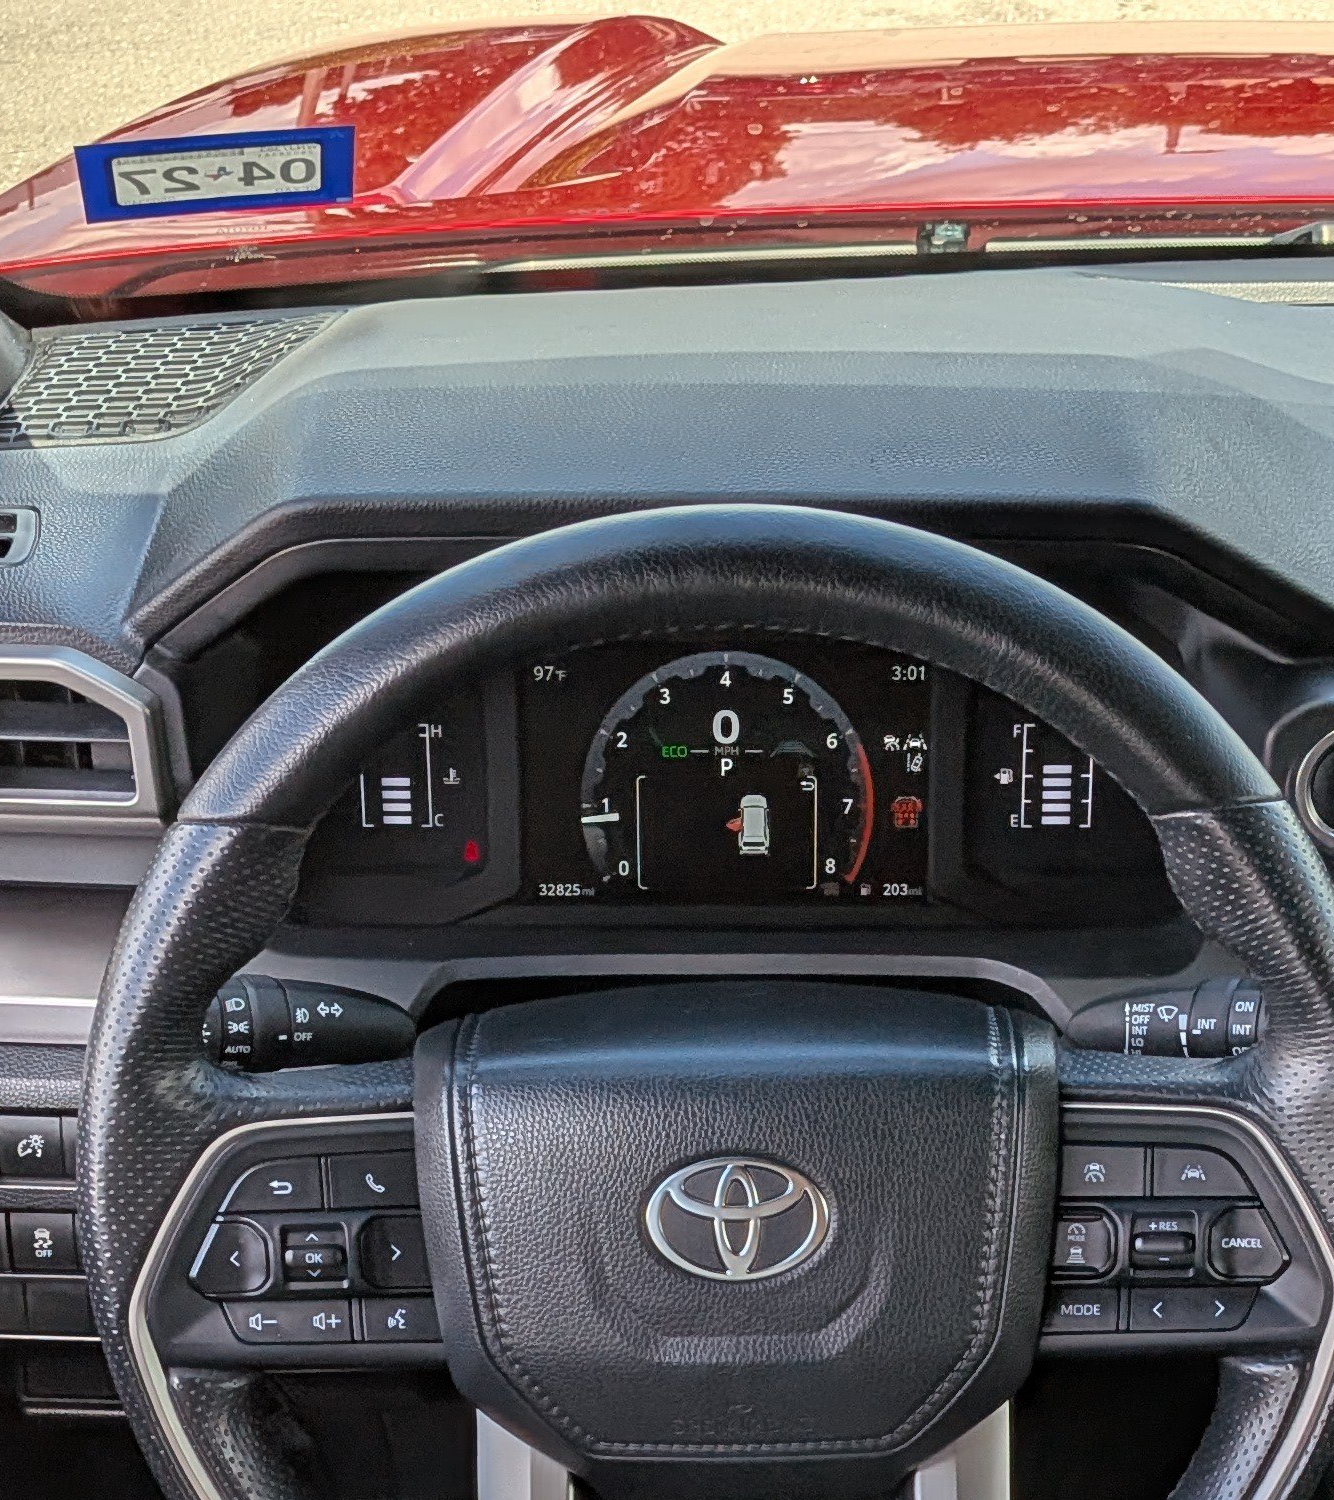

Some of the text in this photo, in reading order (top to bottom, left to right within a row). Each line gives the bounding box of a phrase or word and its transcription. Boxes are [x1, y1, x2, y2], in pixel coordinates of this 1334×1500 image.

[720, 671, 732, 687] 4
[891, 666, 927, 681] 3:01
[659, 689, 671, 705] 3
[782, 689, 794, 705] 5
[430, 725, 443, 738] H
[712, 710, 740, 744] 0
[1013, 724, 1021, 738] F
[616, 732, 628, 748] 2
[826, 734, 838, 749] 6
[662, 745, 688, 758] ECO
[714, 746, 740, 756] MPH
[720, 758, 733, 776] P
[601, 798, 610, 814] 1
[842, 799, 854, 814] 7
[434, 814, 444, 827] C
[1010, 814, 1019, 828] E
[618, 861, 630, 876] 0
[825, 858, 836, 874] 8
[1132, 1003, 1155, 1013] MIST
[1235, 1002, 1255, 1012] ON
[1131, 1015, 1151, 1025] OFF
[1197, 1019, 1217, 1030] INT
[293, 1032, 313, 1042] OFF
[1131, 1026, 1148, 1036] INT
[1232, 1025, 1252, 1036] INT
[1131, 1038, 1144, 1047] LO
[224, 1045, 251, 1054] AUTO
[1221, 1237, 1262, 1249] CANCEL
[34, 1250, 53, 1258] OFF
[305, 1253, 323, 1264] OK
[1061, 1304, 1101, 1316] MODE
